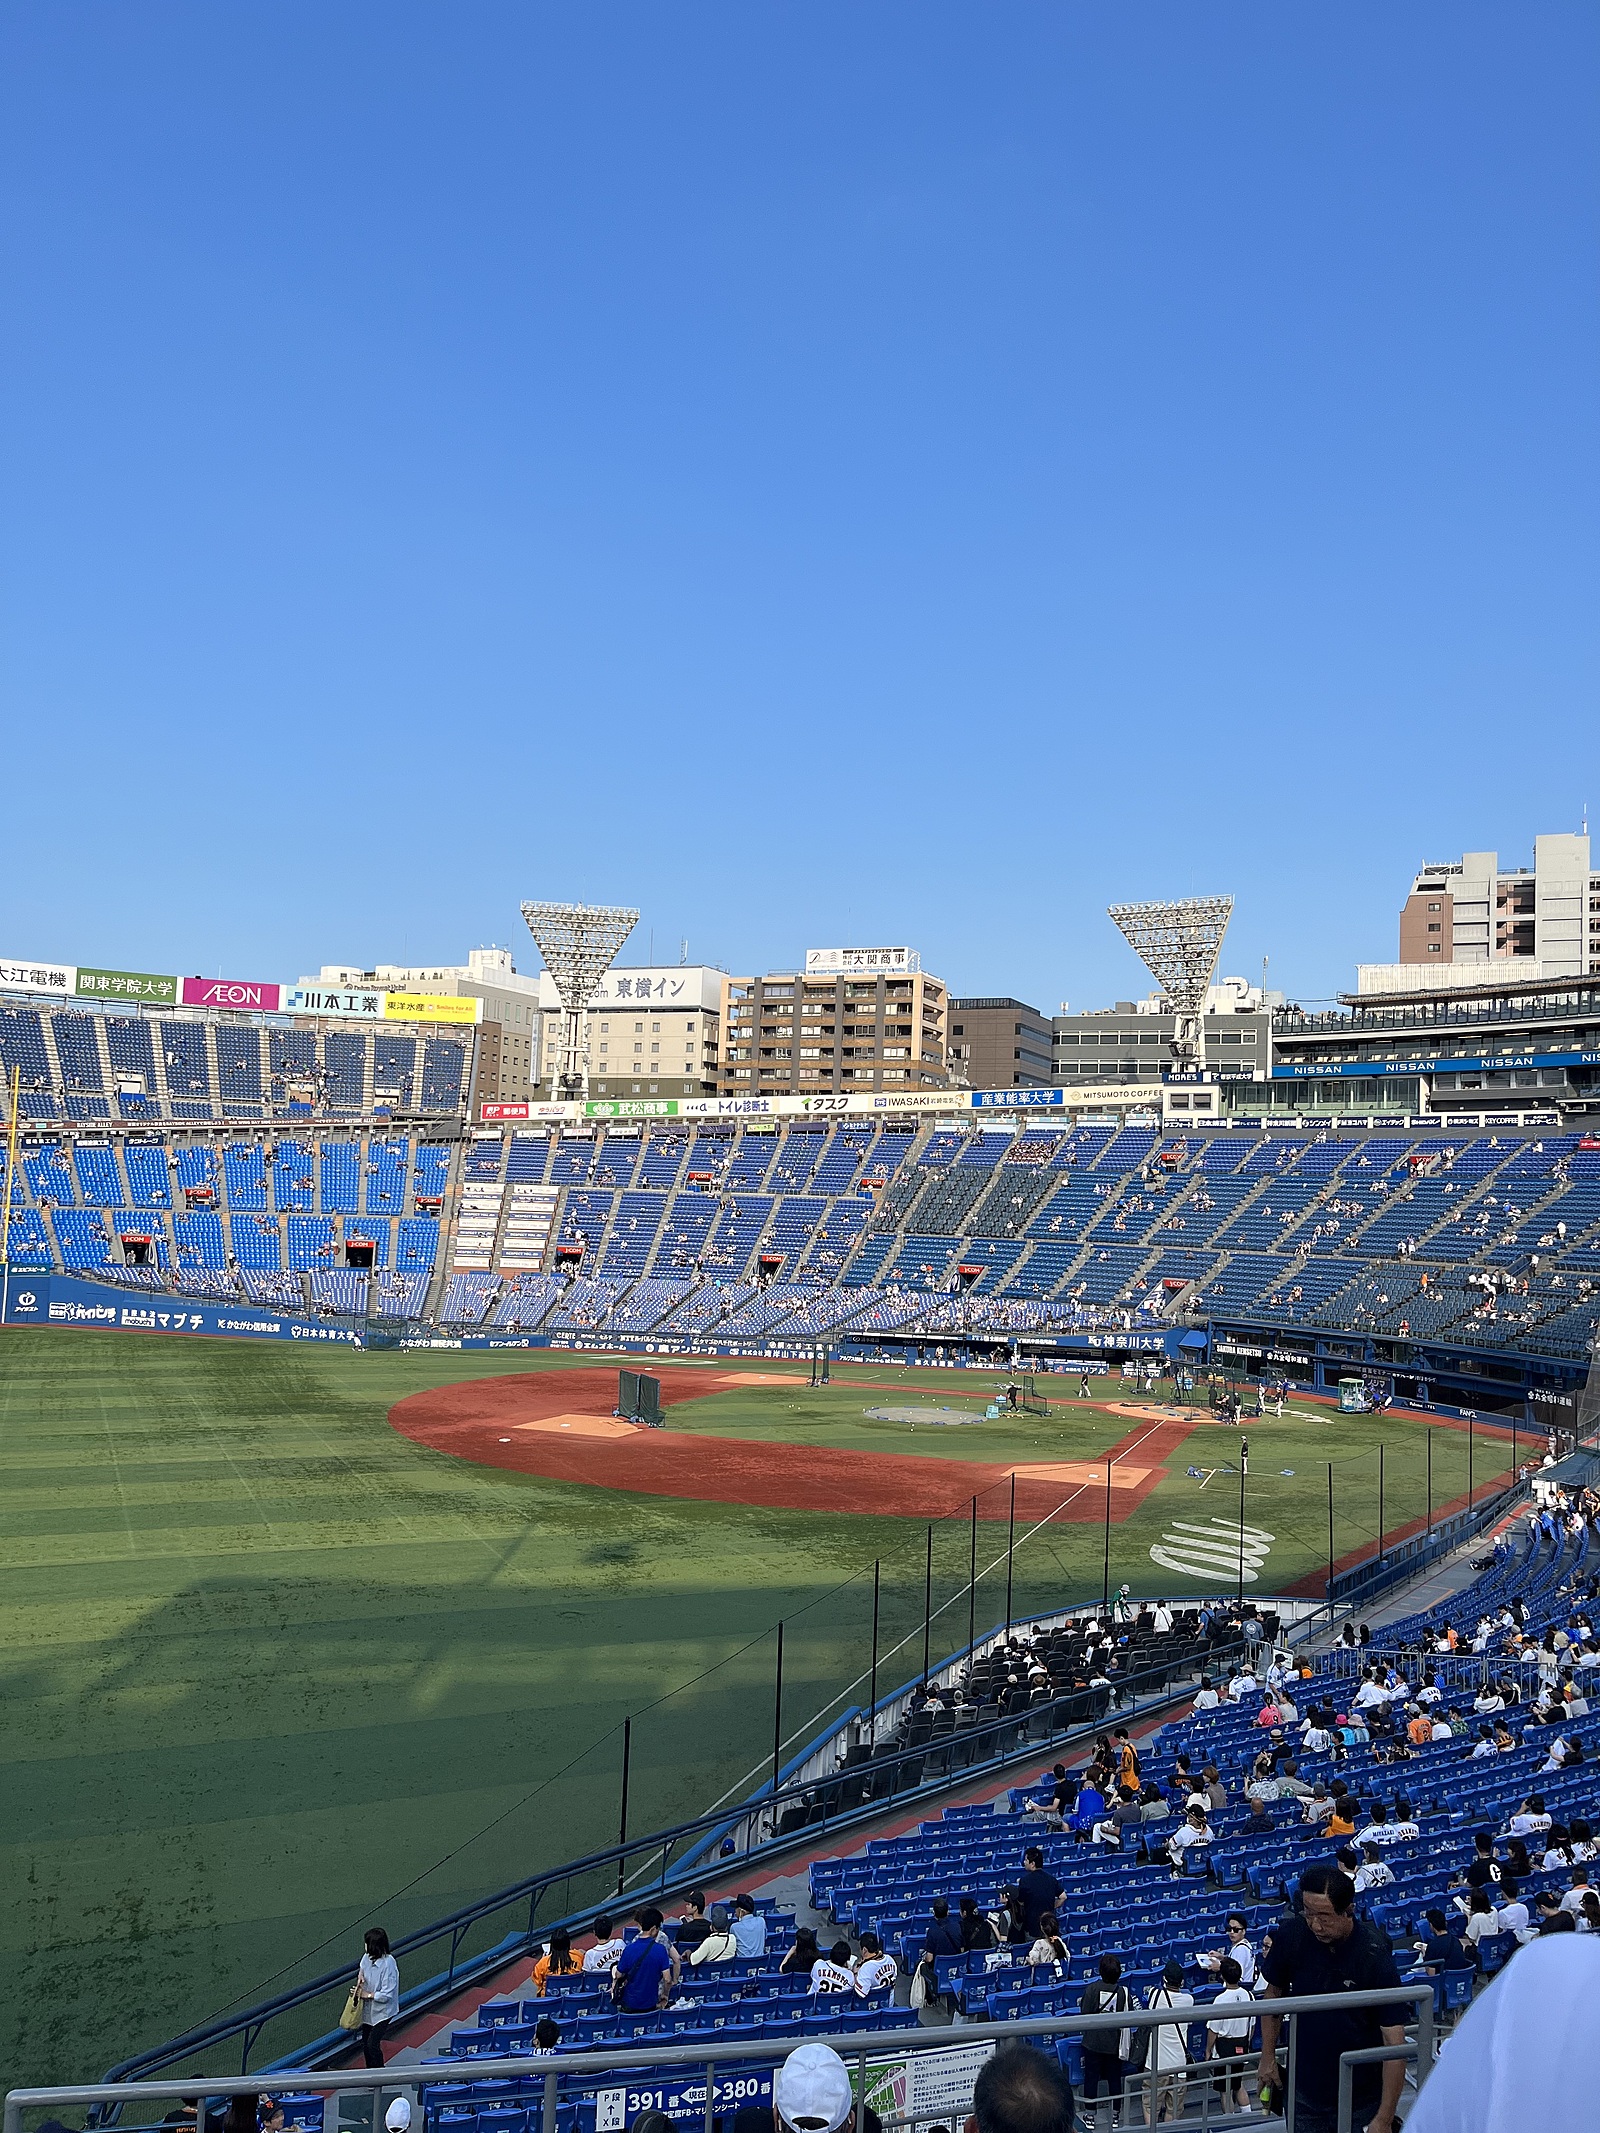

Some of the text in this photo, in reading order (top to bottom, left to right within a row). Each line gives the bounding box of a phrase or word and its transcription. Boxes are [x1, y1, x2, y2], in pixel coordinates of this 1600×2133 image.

[854, 953, 905, 965] 大関商事
[80, 974, 173, 996] 関東学院大学
[615, 977, 686, 999] 東横イン
[305, 992, 379, 1013] 川本工業
[387, 1001, 425, 1013] 東洋水産
[1386, 1062, 1435, 1072] NISSAN
[1481, 1057, 1533, 1068] NISSAN
[1294, 1066, 1342, 1075] NISSAN
[981, 1091, 1055, 1106] 産業能率大学
[1083, 1089, 1164, 1100] MITSUMOTO COFFEE
[618, 1101, 669, 1115] 武松商事
[719, 1099, 769, 1113] トイレ診断士
[813, 1098, 849, 1111] タスク
[888, 1097, 929, 1106] IWASAKI
[125, 1318, 152, 1326] mabuchi
[157, 1313, 204, 1330] マブチ
[227, 1319, 281, 1333] かながわ信用金庫
[302, 1330, 355, 1341] 日本体育大学
[1103, 1335, 1165, 1350] 神奈川大学
[1216, 1344, 1236, 1354] SAKURA
[1236, 1347, 1262, 1358] KENSETSU
[817, 1969, 848, 1987] OKAMOTO
[604, 2092, 621, 2102] P 段
[627, 2090, 663, 2112] 391
[668, 2095, 680, 2108] 番
[722, 2078, 758, 2101] 380
[760, 2081, 771, 2095] 番
[602, 2117, 621, 2127] X 段
